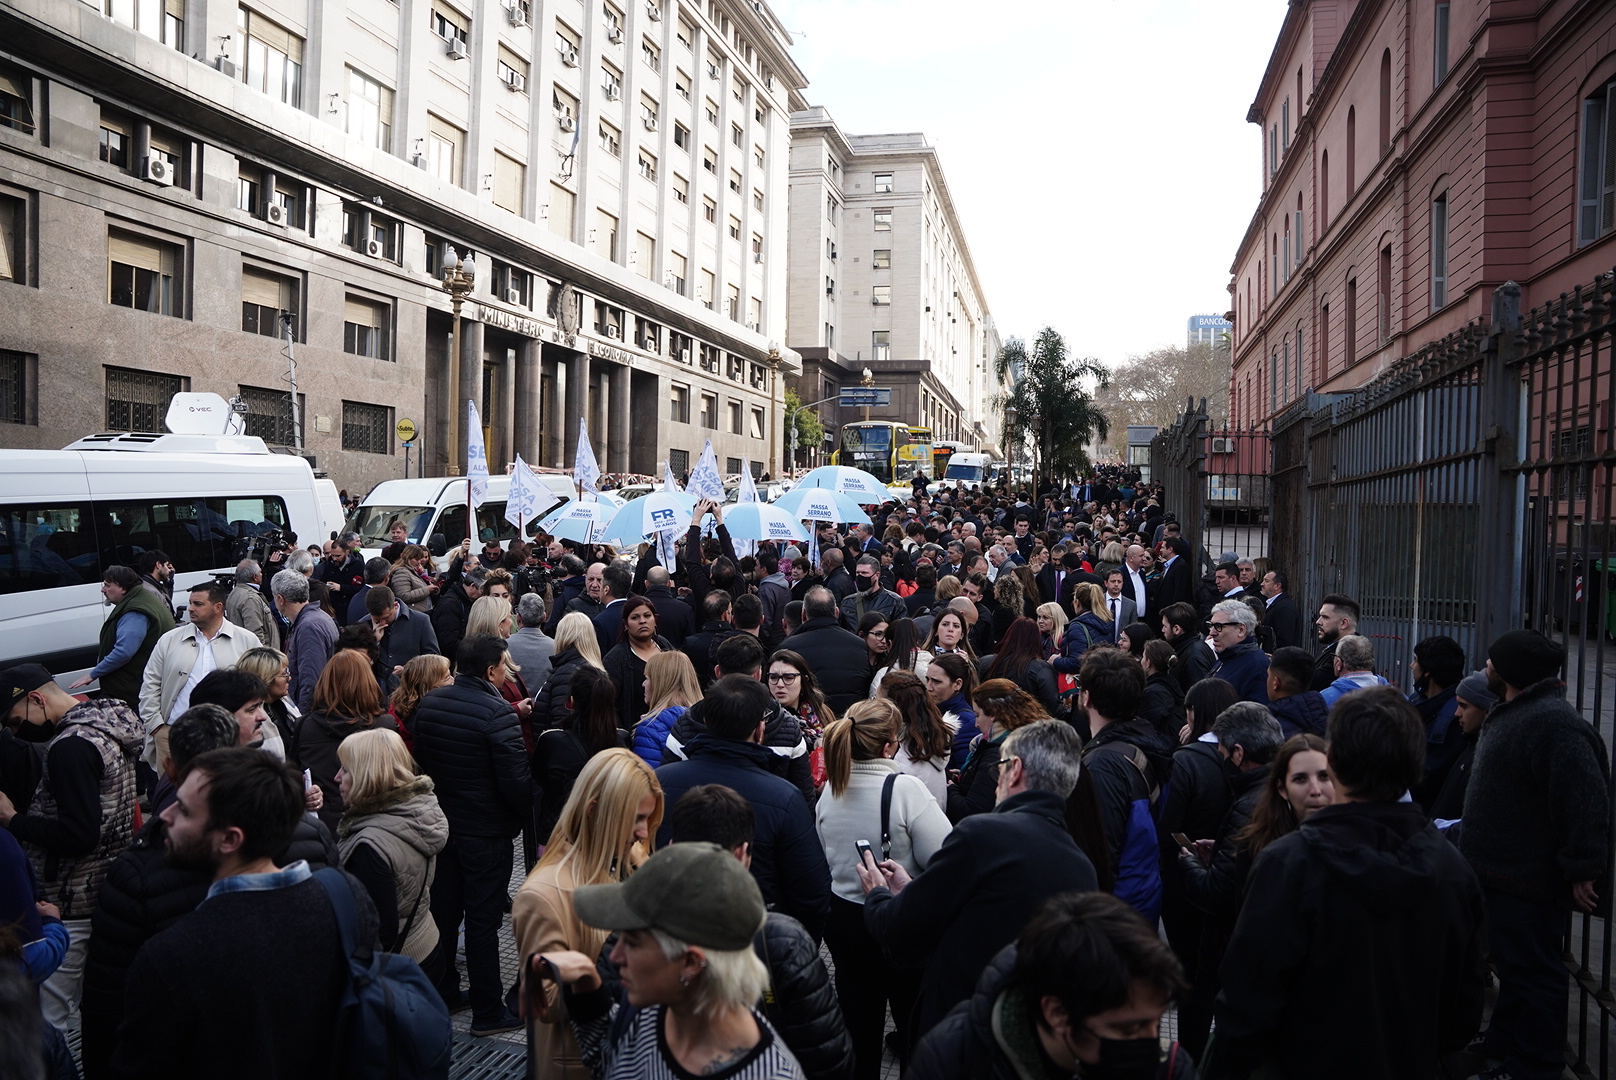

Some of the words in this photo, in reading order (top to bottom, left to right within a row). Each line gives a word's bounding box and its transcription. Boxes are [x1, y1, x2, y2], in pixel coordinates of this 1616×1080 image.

[485, 307, 545, 338] MINISTERIO
[843, 482, 866, 490] SERRANO
[651, 509, 674, 521] FR
[807, 509, 832, 517] SERRANO
[769, 528, 792, 536] SERRANO
